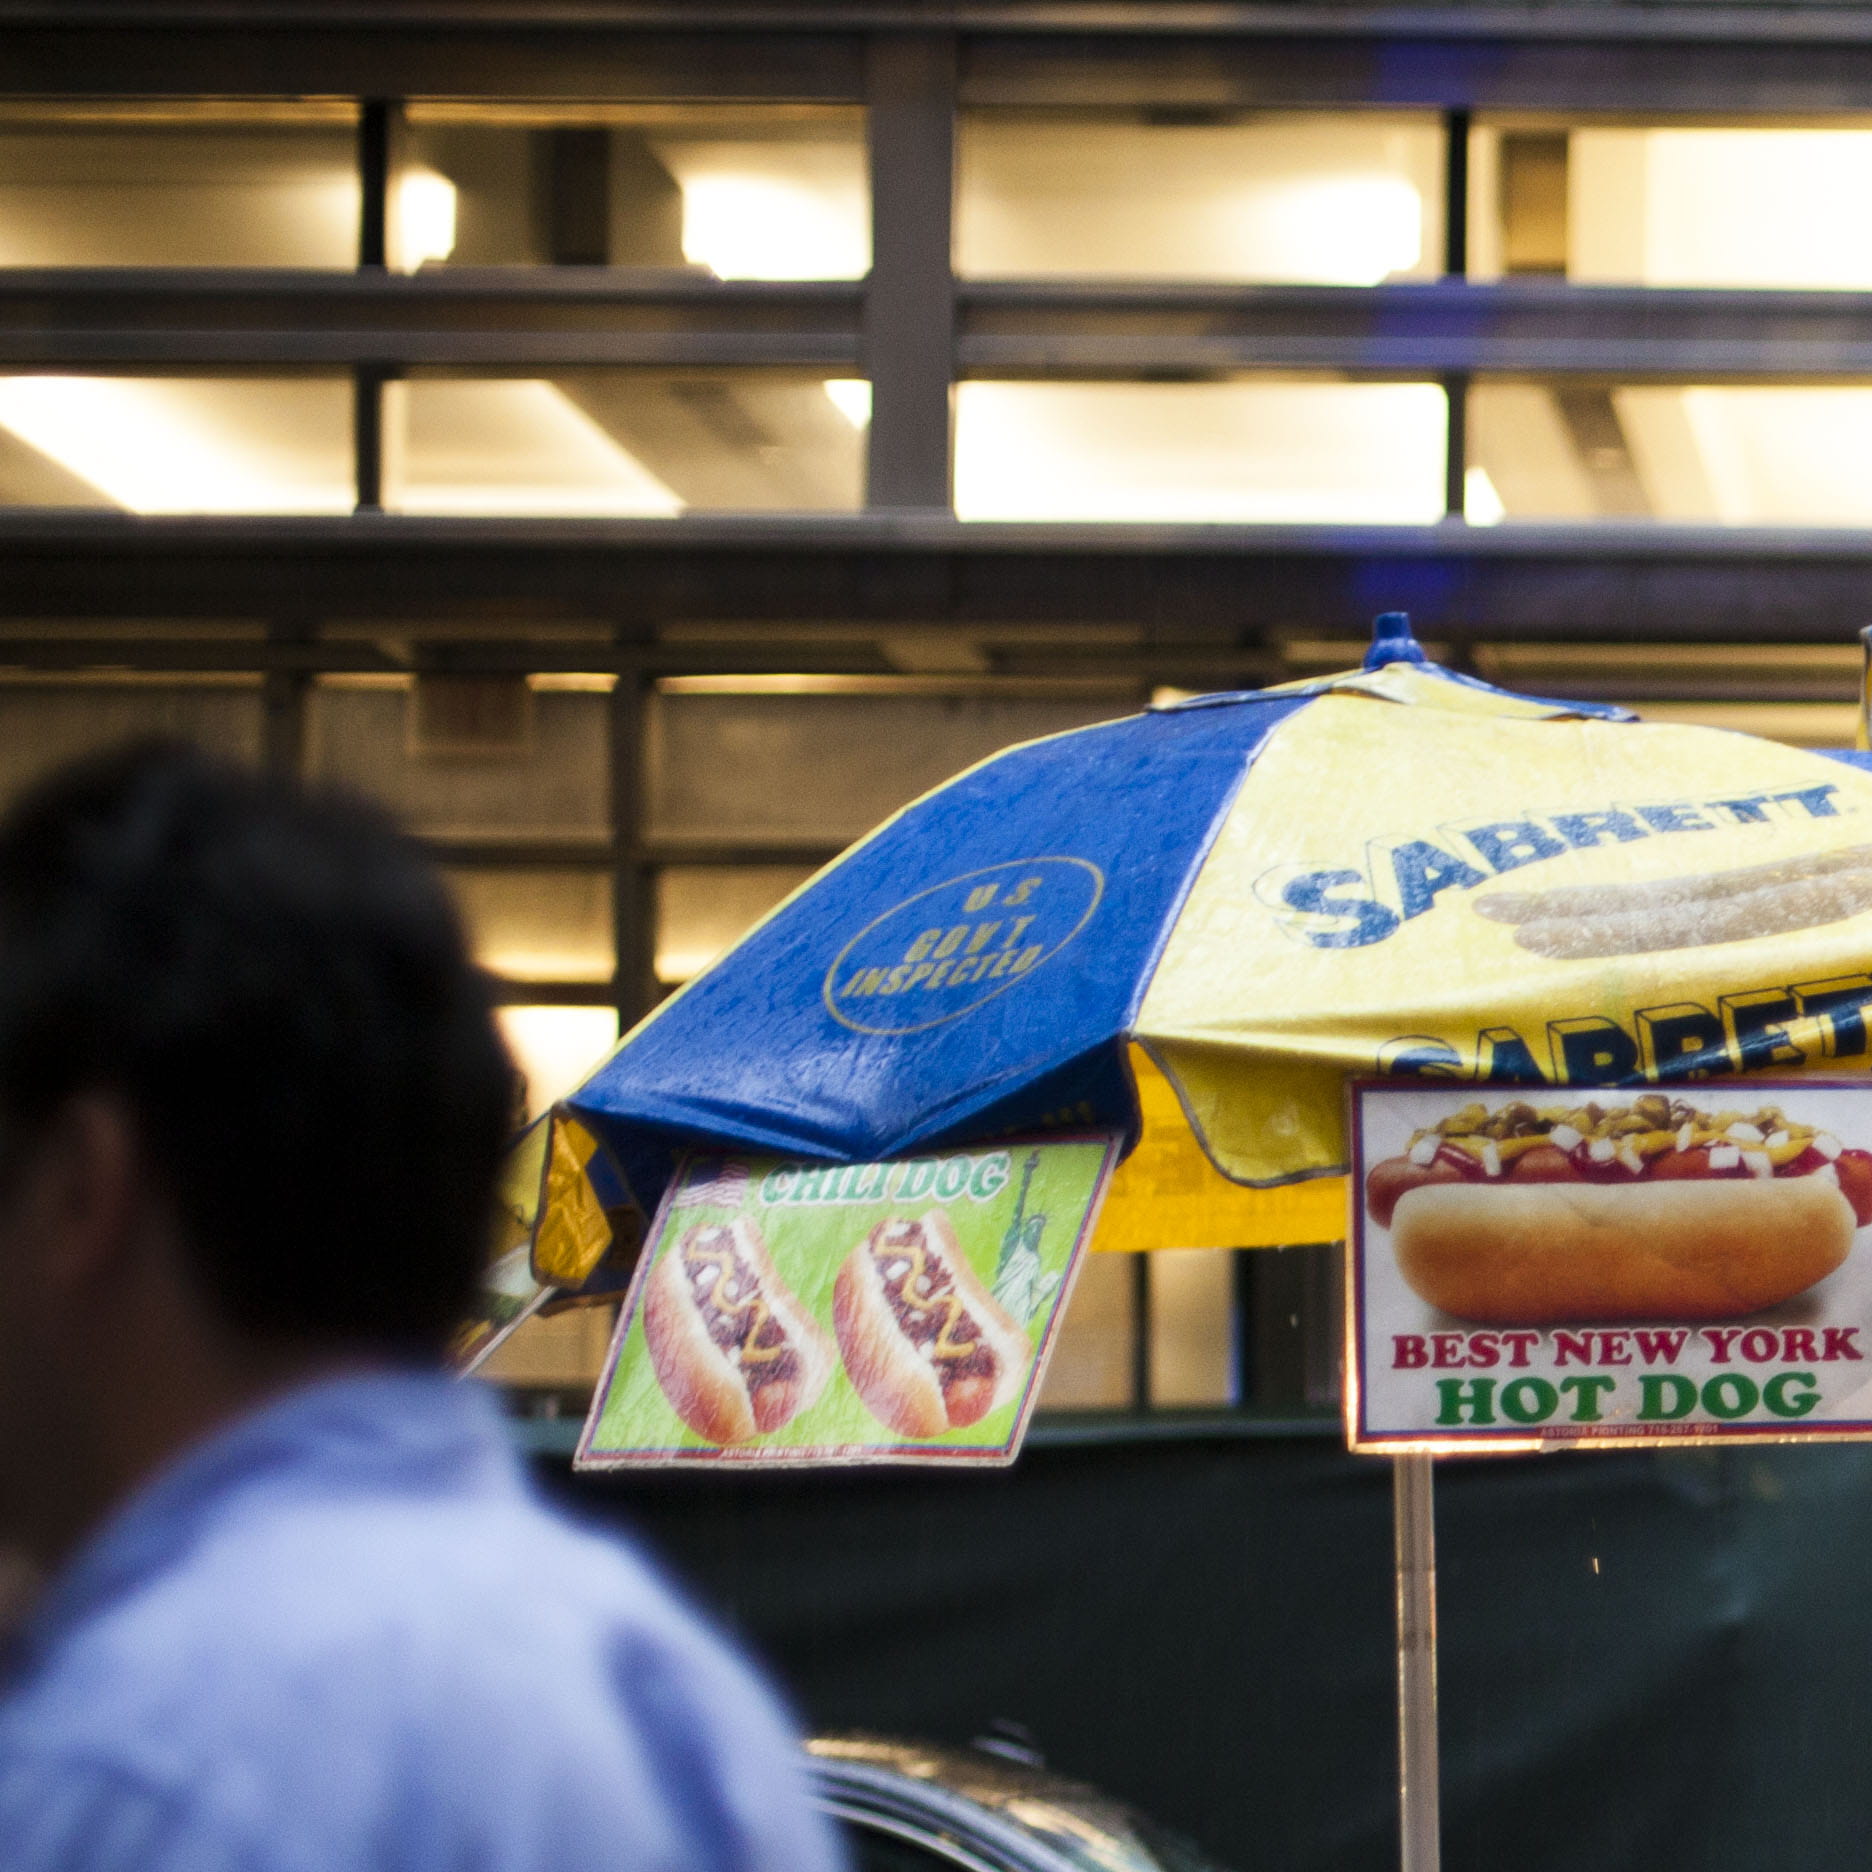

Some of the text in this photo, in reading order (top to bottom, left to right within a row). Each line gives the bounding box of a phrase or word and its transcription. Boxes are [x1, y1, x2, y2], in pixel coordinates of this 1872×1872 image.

[1254, 780, 1840, 949] SABRETT
[840, 944, 1043, 997] INSPECTED
[760, 1151, 1011, 1206] CHILI DOG
[1392, 1326, 1864, 1370] BEST NEW YORK
[1434, 1371, 1822, 1425] HOT DOG
